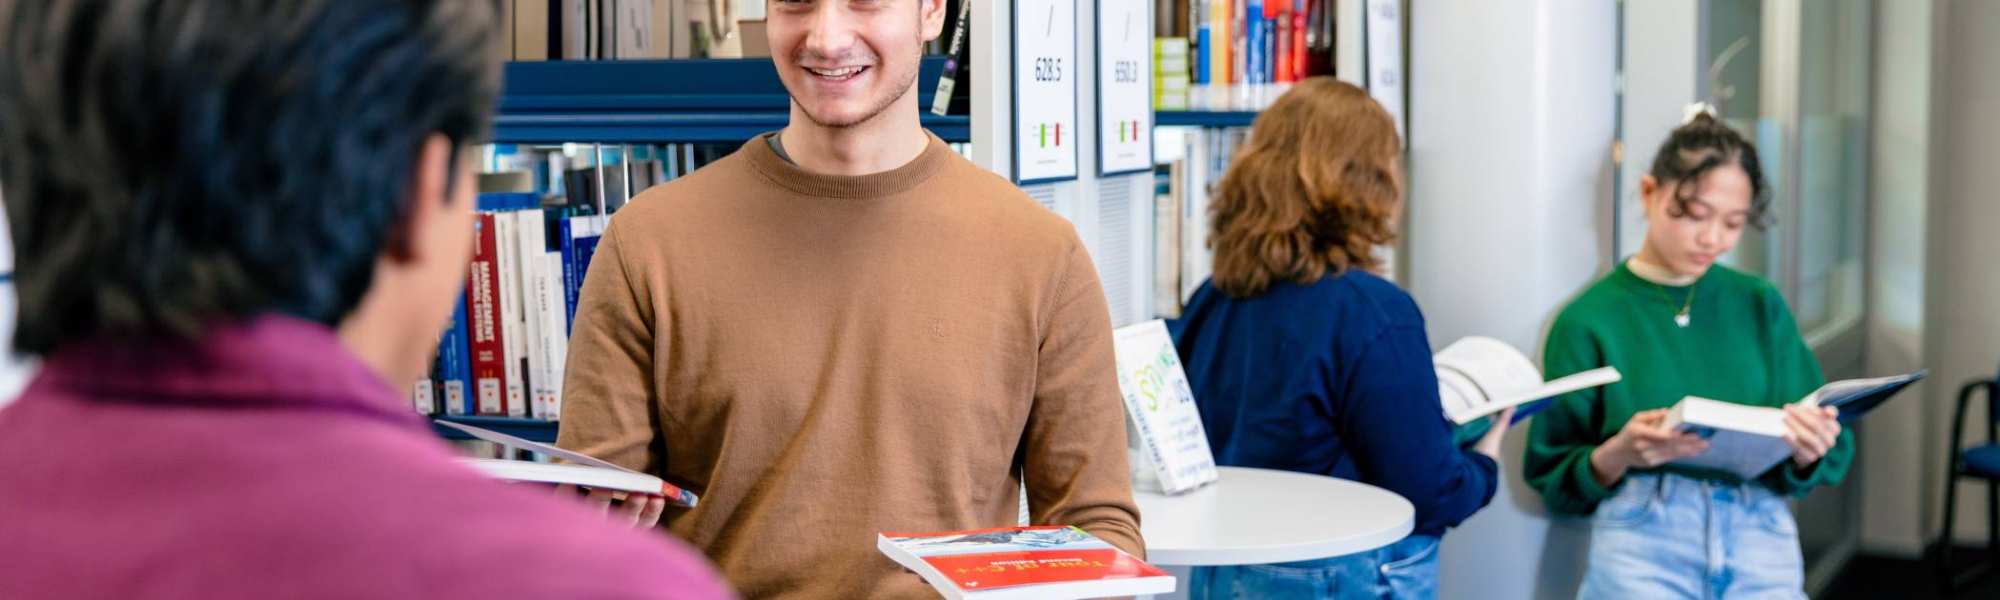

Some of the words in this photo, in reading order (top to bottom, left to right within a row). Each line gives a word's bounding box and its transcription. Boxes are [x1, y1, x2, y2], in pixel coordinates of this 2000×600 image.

[1036, 57, 1061, 82] 628.5
[471, 261, 482, 302] CONTROL
[480, 261, 495, 342] MANAGEMENT
[474, 303, 485, 343] SYSTEMS
